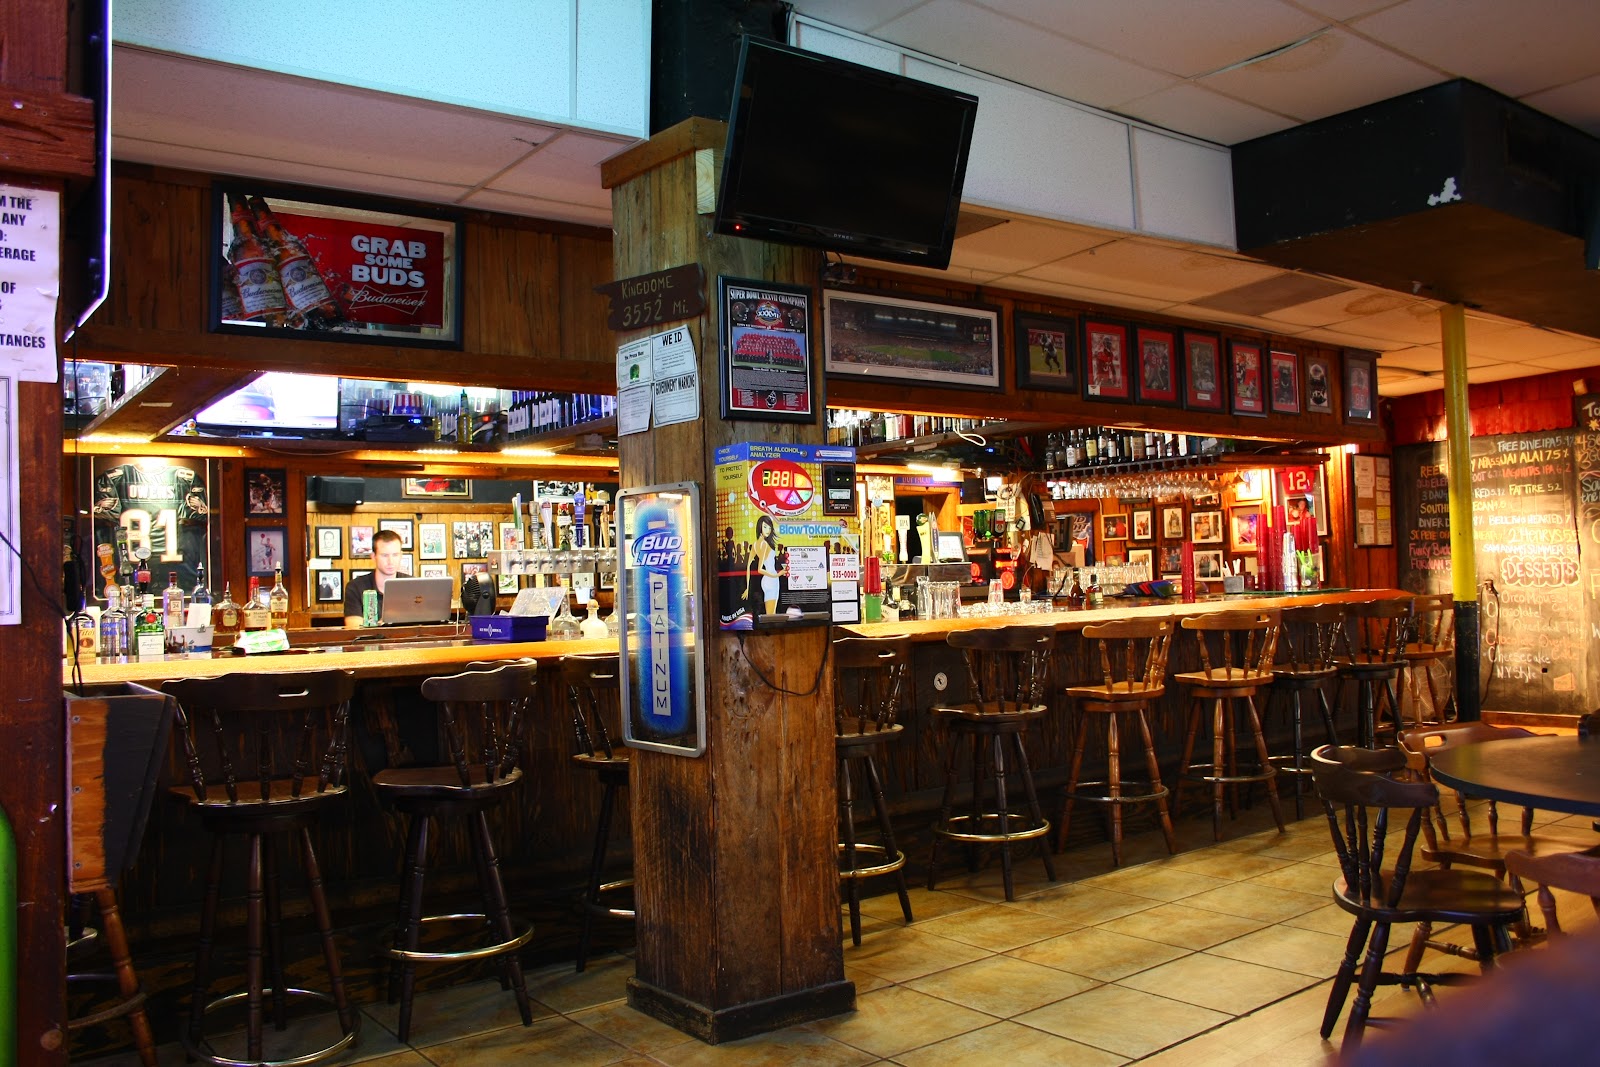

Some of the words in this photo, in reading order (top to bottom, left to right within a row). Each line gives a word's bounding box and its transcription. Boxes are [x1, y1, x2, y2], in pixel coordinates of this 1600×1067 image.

[10, 196, 33, 211] THE
[2, 212, 27, 227] ANY
[351, 234, 427, 259] GRAB
[364, 253, 413, 270] SOME
[351, 264, 425, 288] BUDS
[1, 281, 17, 295] OF
[353, 288, 426, 307] Budweiser
[730, 289, 746, 300] SUPER
[746, 290, 761, 300] BOWL
[778, 295, 806, 309] CHAMPIONS
[622, 298, 663, 327] 3552
[661, 333, 673, 347] WE
[674, 331, 683, 344] ID
[655, 378, 678, 396] GOVERNMENT
[678, 374, 695, 391] WARNING
[1497, 440, 1518, 453] FREE
[1519, 439, 1542, 451] DIVE
[1542, 438, 1556, 449] IPA
[749, 451, 781, 459] ANALYZER
[1500, 453, 1517, 466] JAI
[1519, 449, 1544, 464] ALAI
[725, 464, 743, 472] PROTECT
[1542, 464, 1556, 474] IPA
[723, 473, 743, 481] YOURSELF
[1288, 470, 1307, 491] 12
[128, 484, 176, 500] OWENS
[1474, 488, 1489, 499] RED
[1509, 484, 1521, 496] FAT
[1521, 483, 1545, 494] TIRE
[779, 524, 842, 535] BlowToKnow
[1418, 517, 1445, 528] DIVER
[119, 509, 184, 563] 81
[640, 535, 682, 551] BUD
[1508, 528, 1521, 544] 2
[121, 542, 129, 562] IPA
[1525, 544, 1565, 555] SUMMER
[632, 551, 686, 567] LIGHT
[1506, 561, 1576, 580] DESSERTS
[653, 581, 668, 709] PLATINUM
[1487, 645, 1552, 664] Cheesecake
